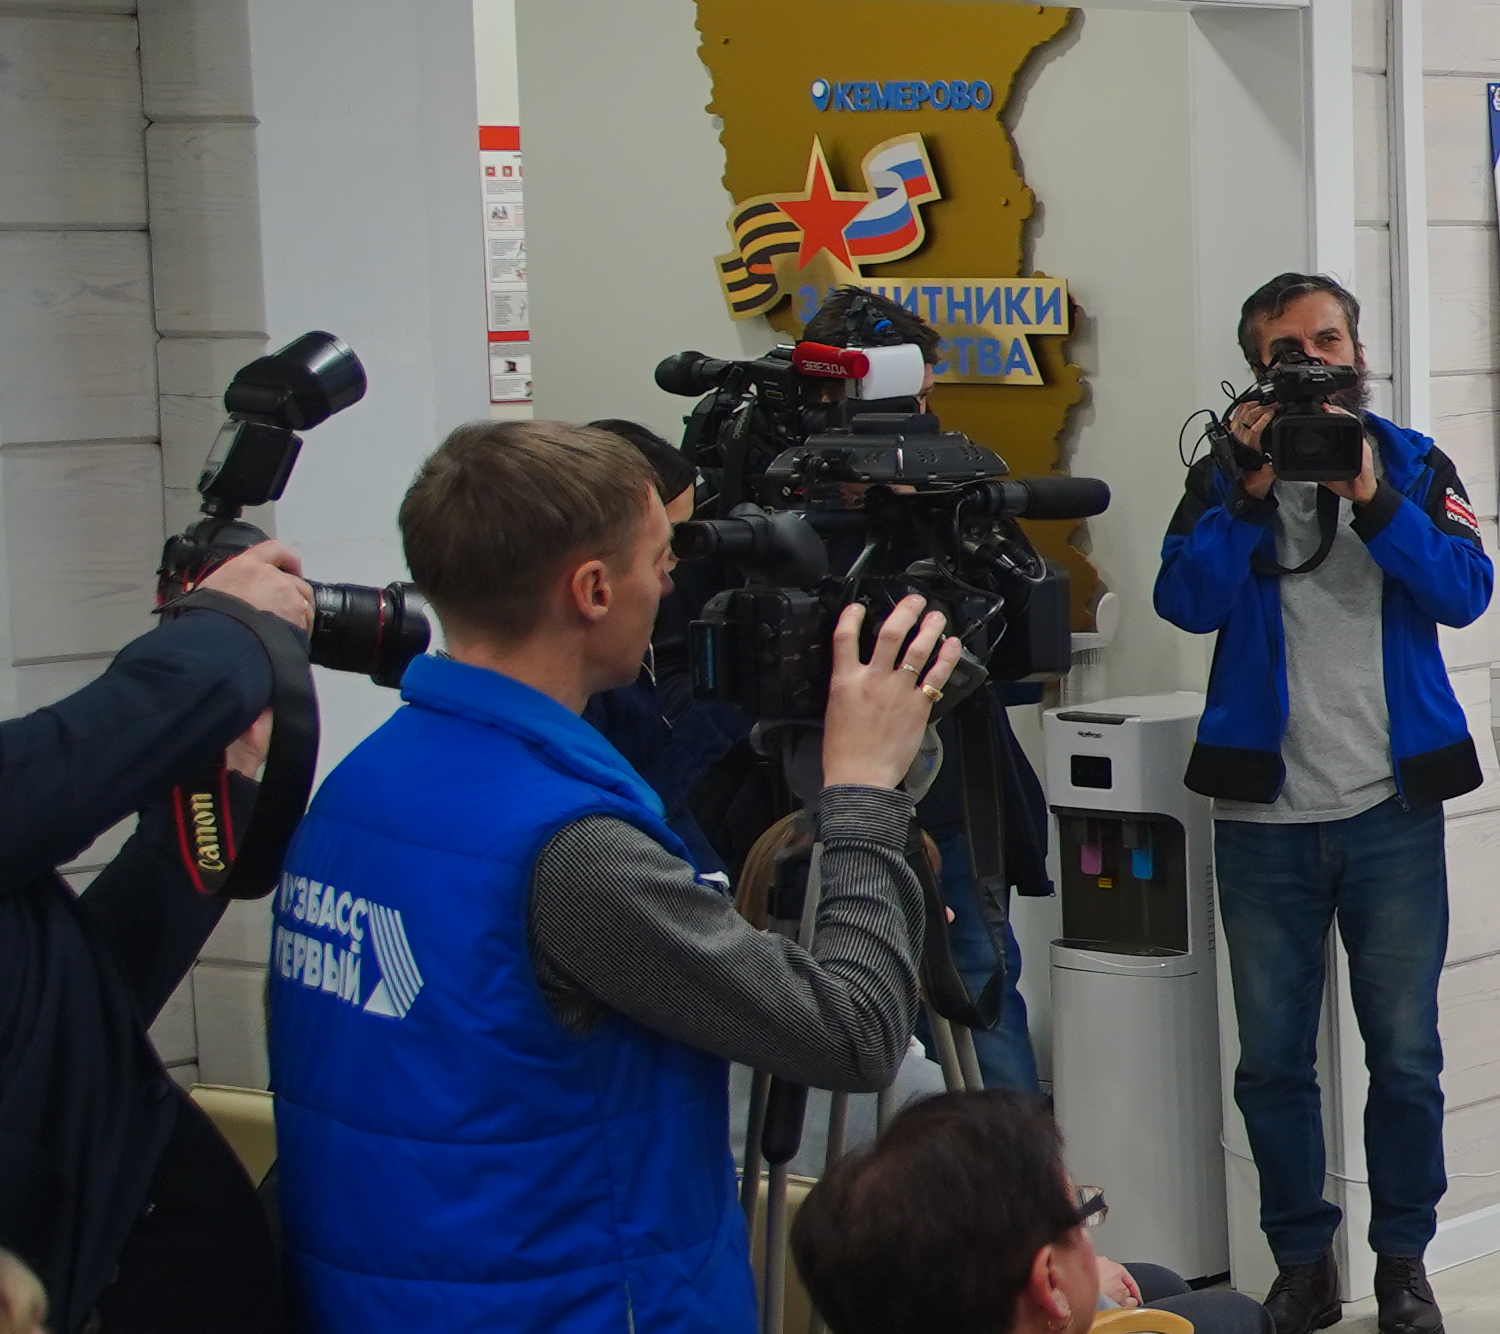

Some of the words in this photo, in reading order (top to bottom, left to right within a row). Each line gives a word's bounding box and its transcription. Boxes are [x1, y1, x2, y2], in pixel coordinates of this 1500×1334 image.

[833, 80, 992, 110] КЕМЕРОВО
[798, 284, 1062, 325] ЗИТНИКИ
[802, 359, 849, 376] ЗВЕЗДА
[190, 793, 225, 871] Canon
